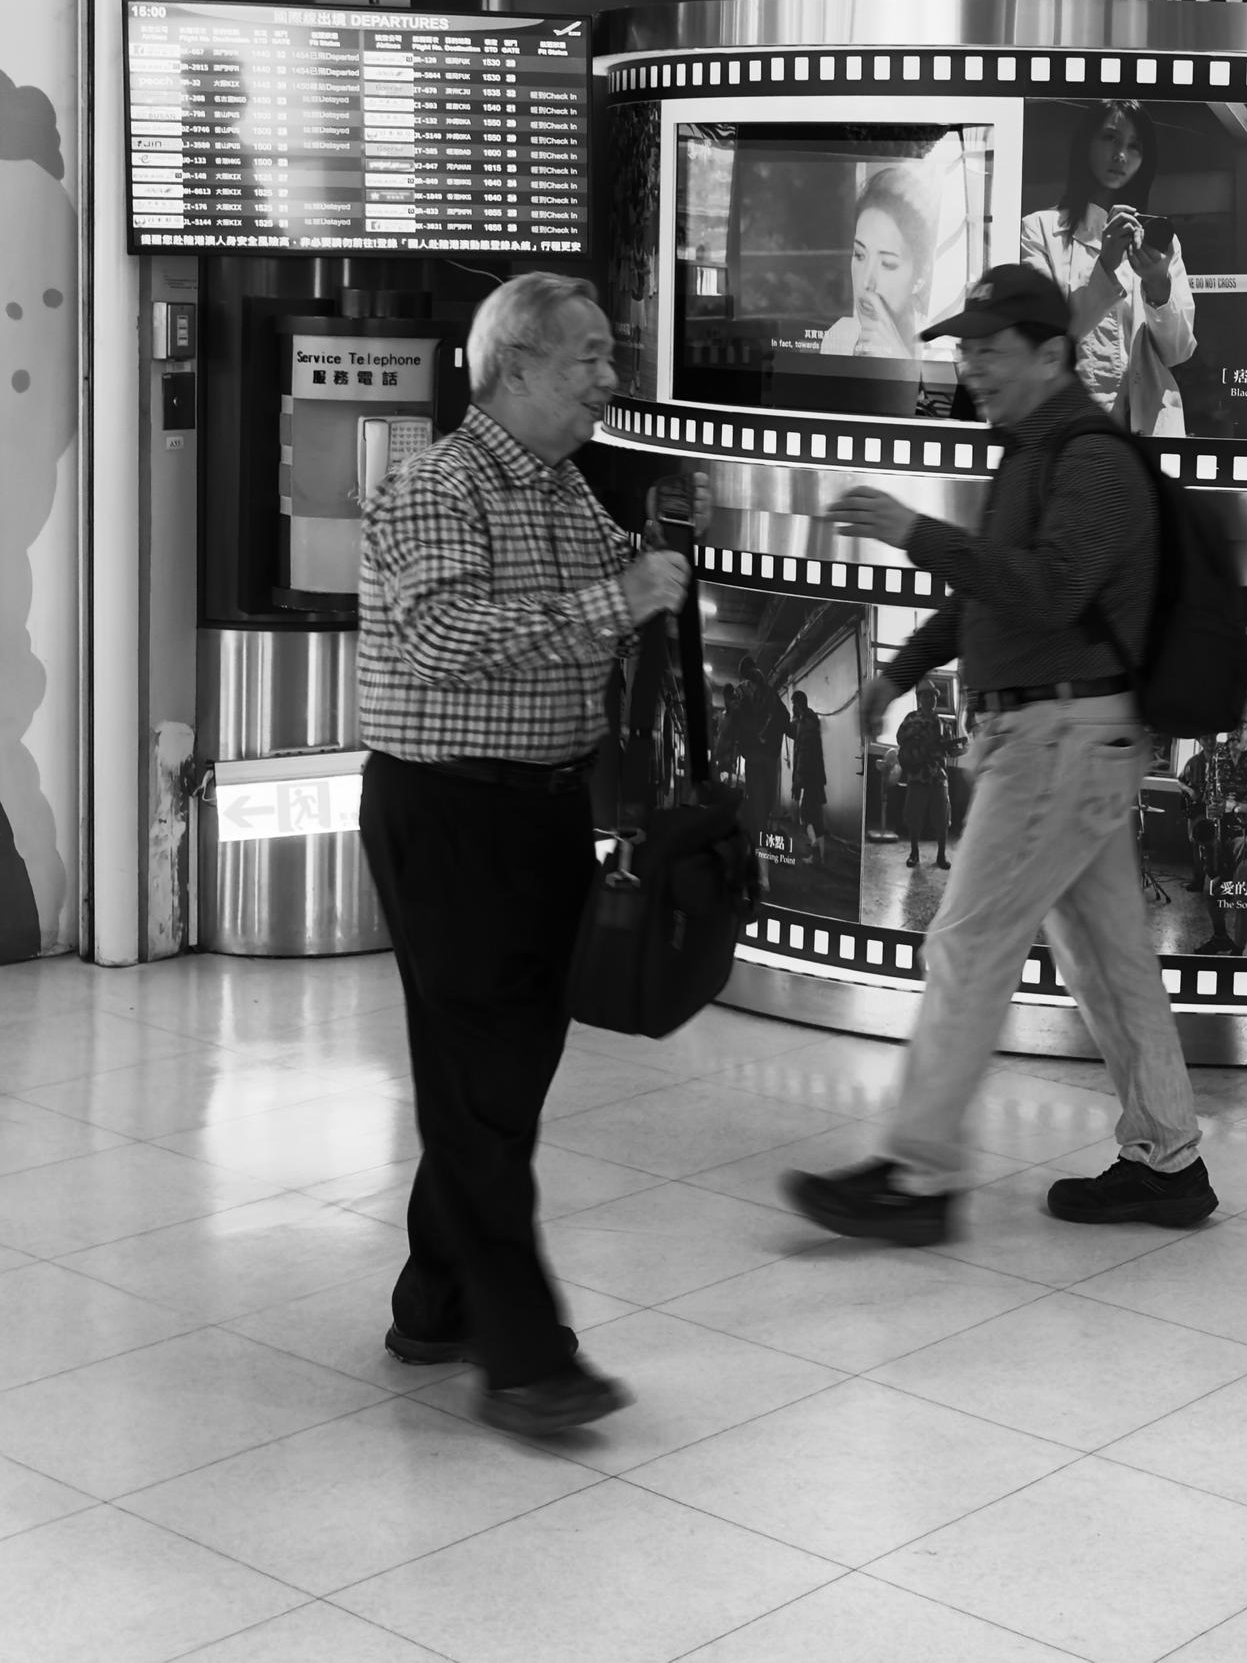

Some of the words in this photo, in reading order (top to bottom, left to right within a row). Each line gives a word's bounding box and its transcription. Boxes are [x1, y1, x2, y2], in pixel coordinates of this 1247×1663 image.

[350, 14, 449, 30] DEPARTURES
[482, 58, 500, 67] 1530
[483, 104, 501, 113] 1540
[1195, 278, 1204, 288] DO
[1205, 278, 1216, 288] NOT
[1218, 277, 1237, 288] CROSS
[779, 339, 793, 348] fact,
[795, 340, 819, 350] towards
[297, 350, 342, 364] Service
[348, 352, 422, 367] Telephone
[312, 370, 398, 386] 服務電話
[780, 854, 796, 866] Point
[1217, 899, 1235, 909] The
